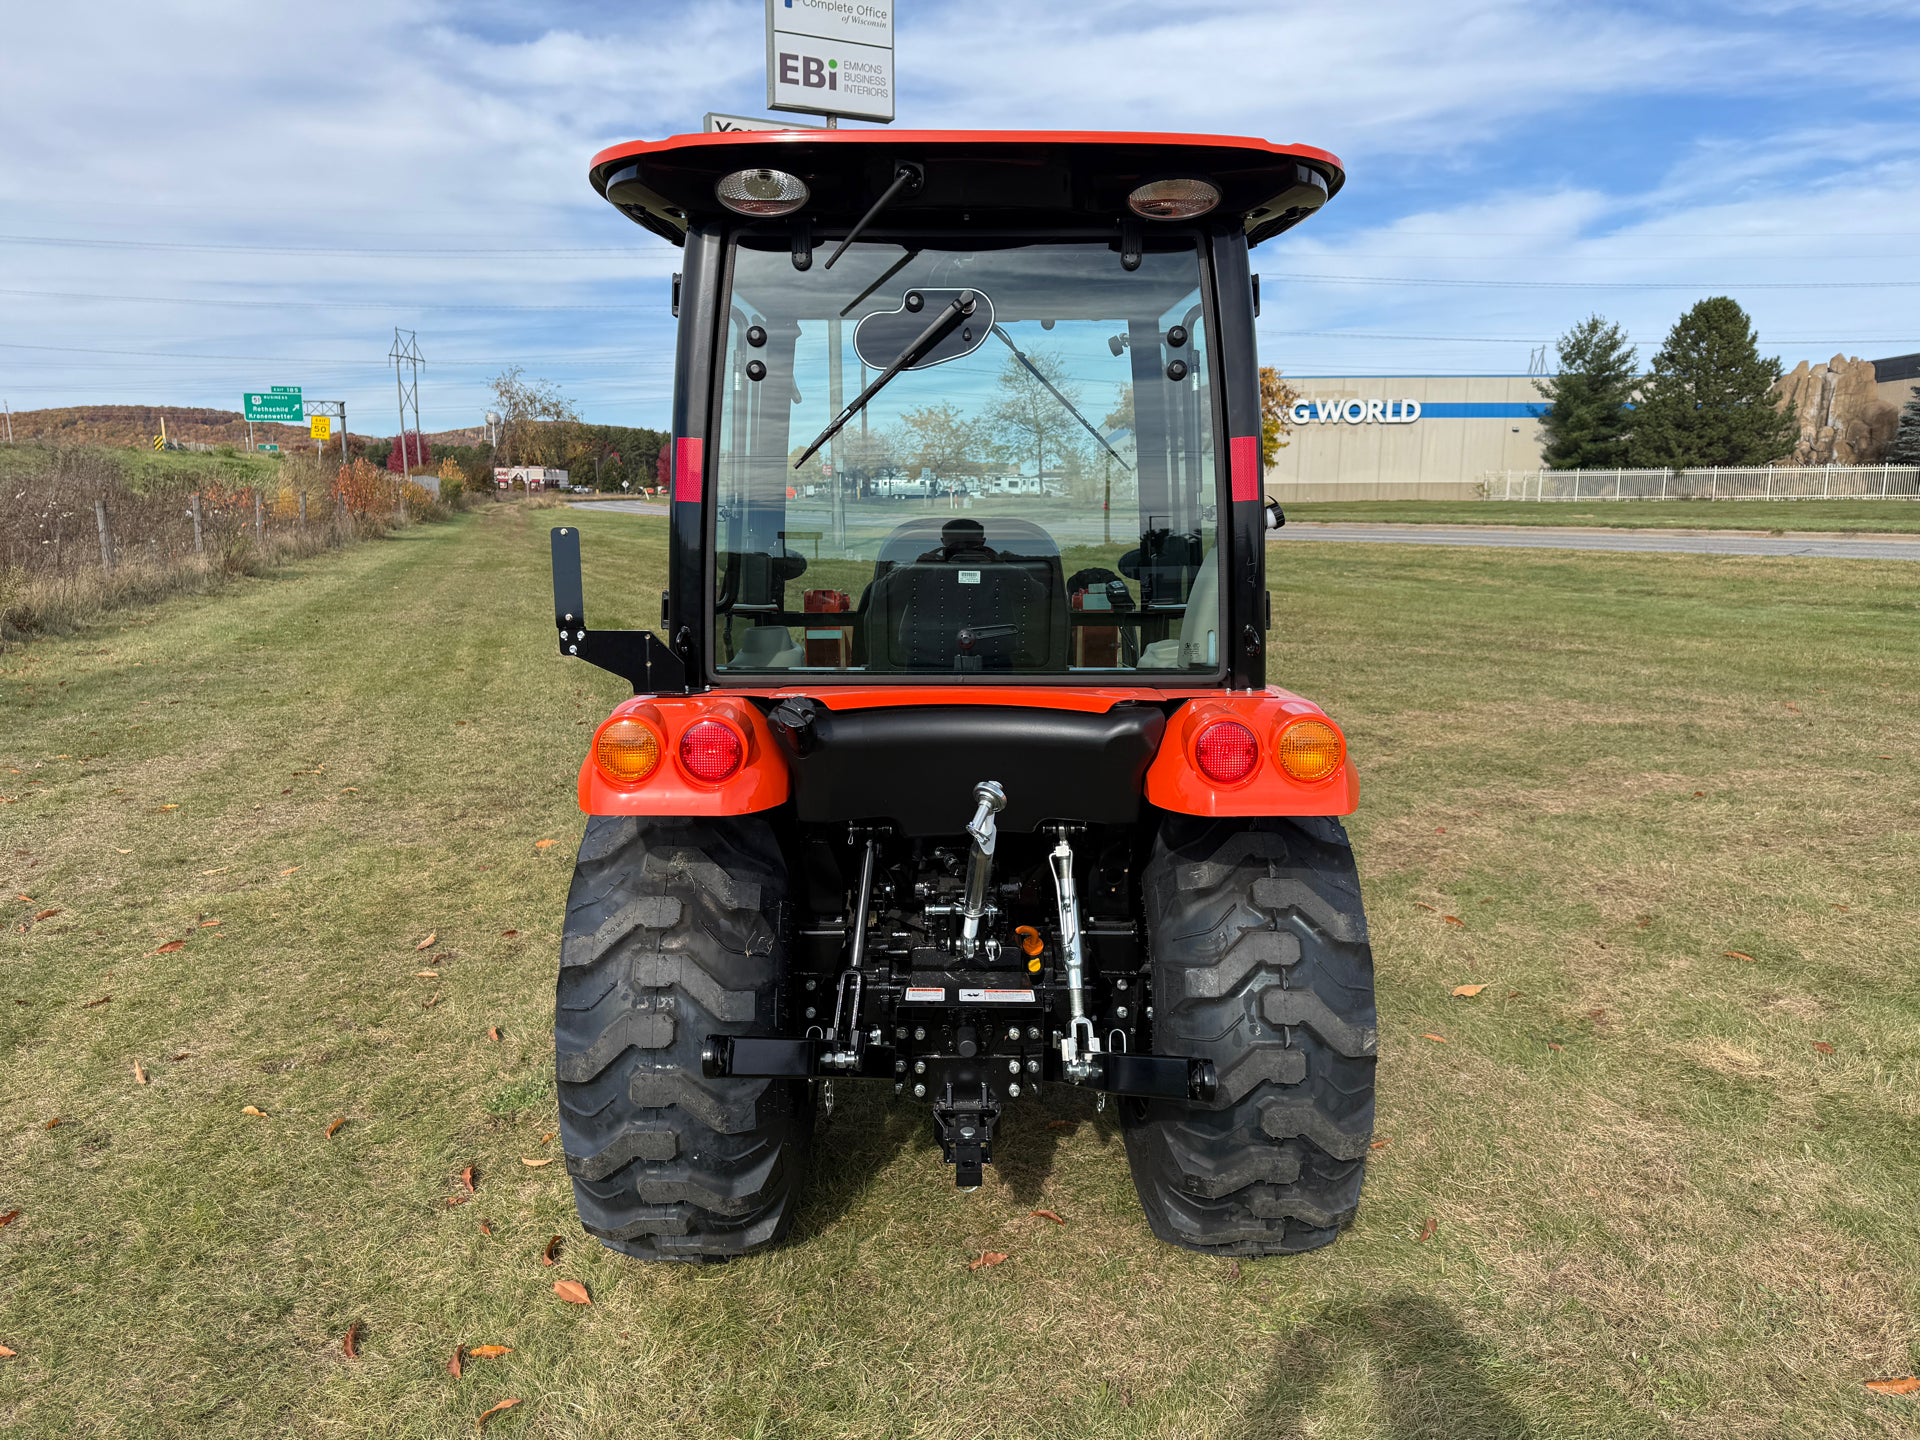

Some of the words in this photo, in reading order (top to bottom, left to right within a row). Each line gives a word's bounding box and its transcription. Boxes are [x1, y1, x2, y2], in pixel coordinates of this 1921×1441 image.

[802, 0, 854, 14] Complete
[856, 5, 887, 19] Office
[841, 15, 850, 24] of
[851, 16, 887, 29] Wisconsin
[779, 52, 838, 91] EBi
[843, 60, 882, 74] EMMONS
[844, 72, 886, 86] BUSINESS
[844, 84, 888, 98] INTERIORS
[1314, 398, 1421, 425] WORLD
[314, 425, 327, 433] 50
